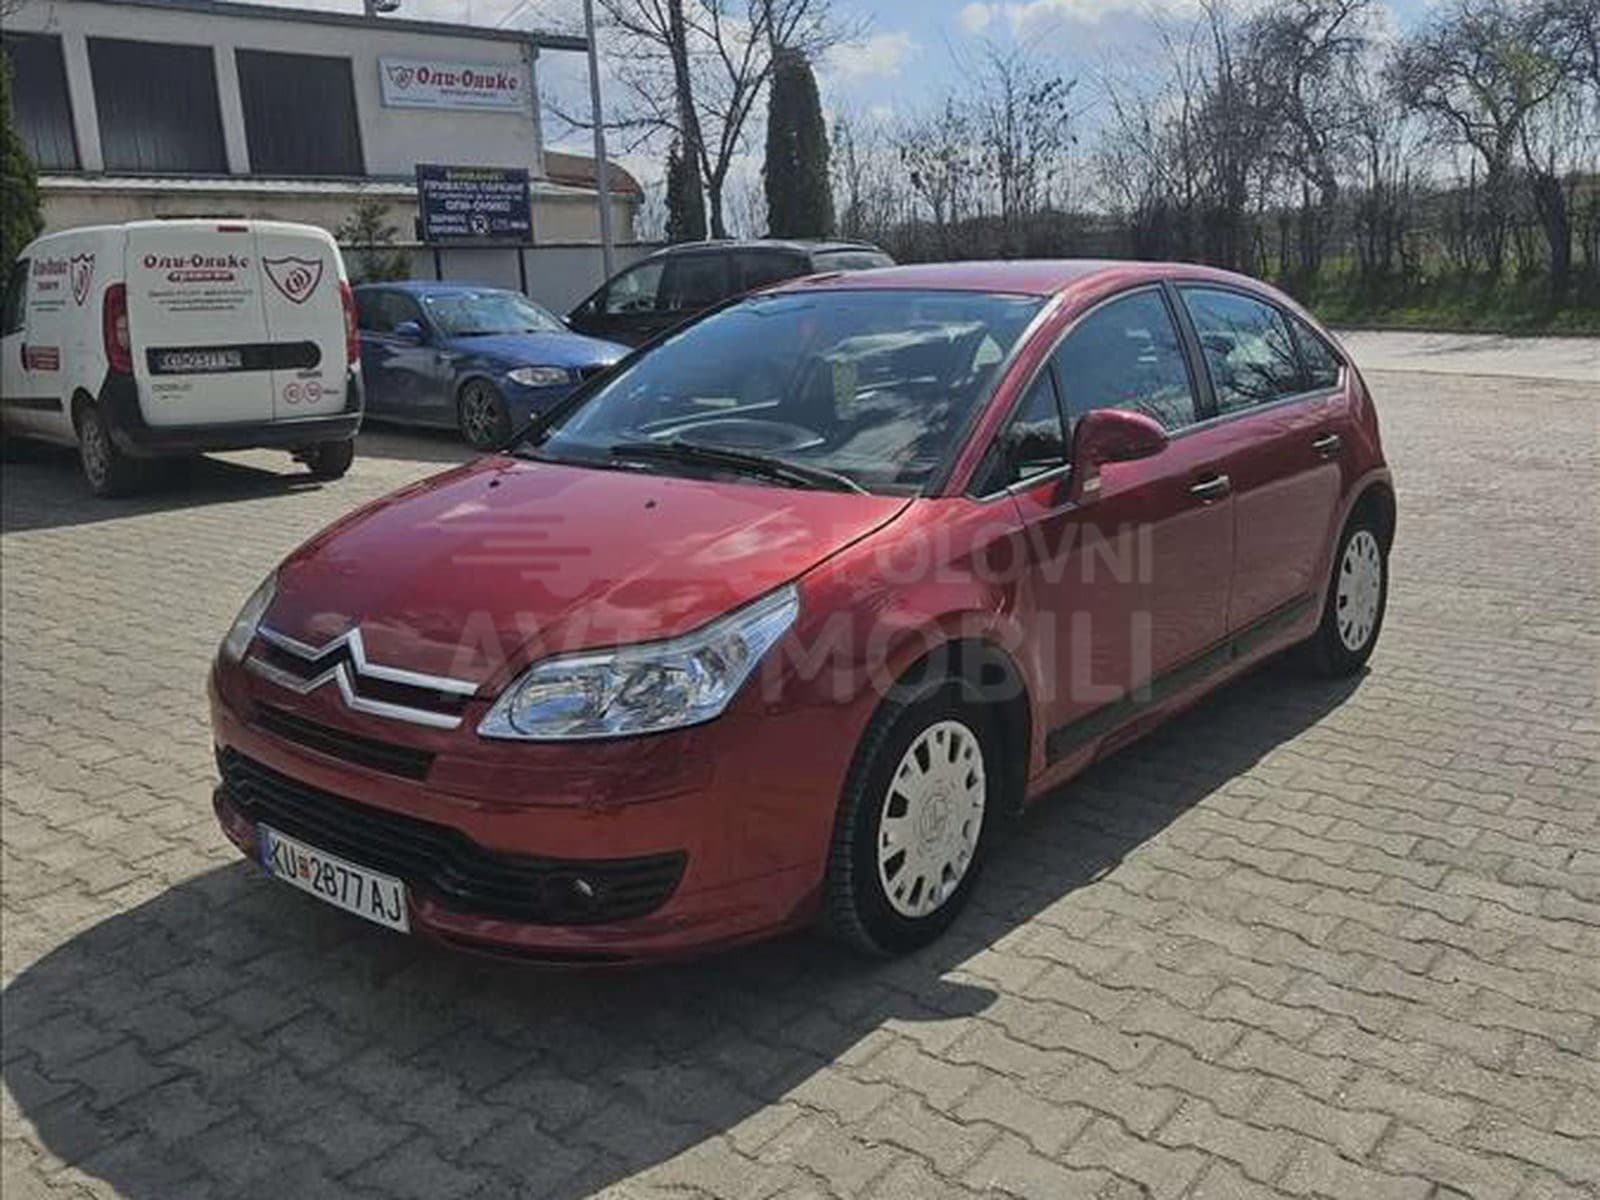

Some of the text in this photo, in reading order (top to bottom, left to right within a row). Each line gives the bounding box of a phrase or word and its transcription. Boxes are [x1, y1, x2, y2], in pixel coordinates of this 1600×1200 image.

[269, 838, 402, 922] KU 2877 AJ
